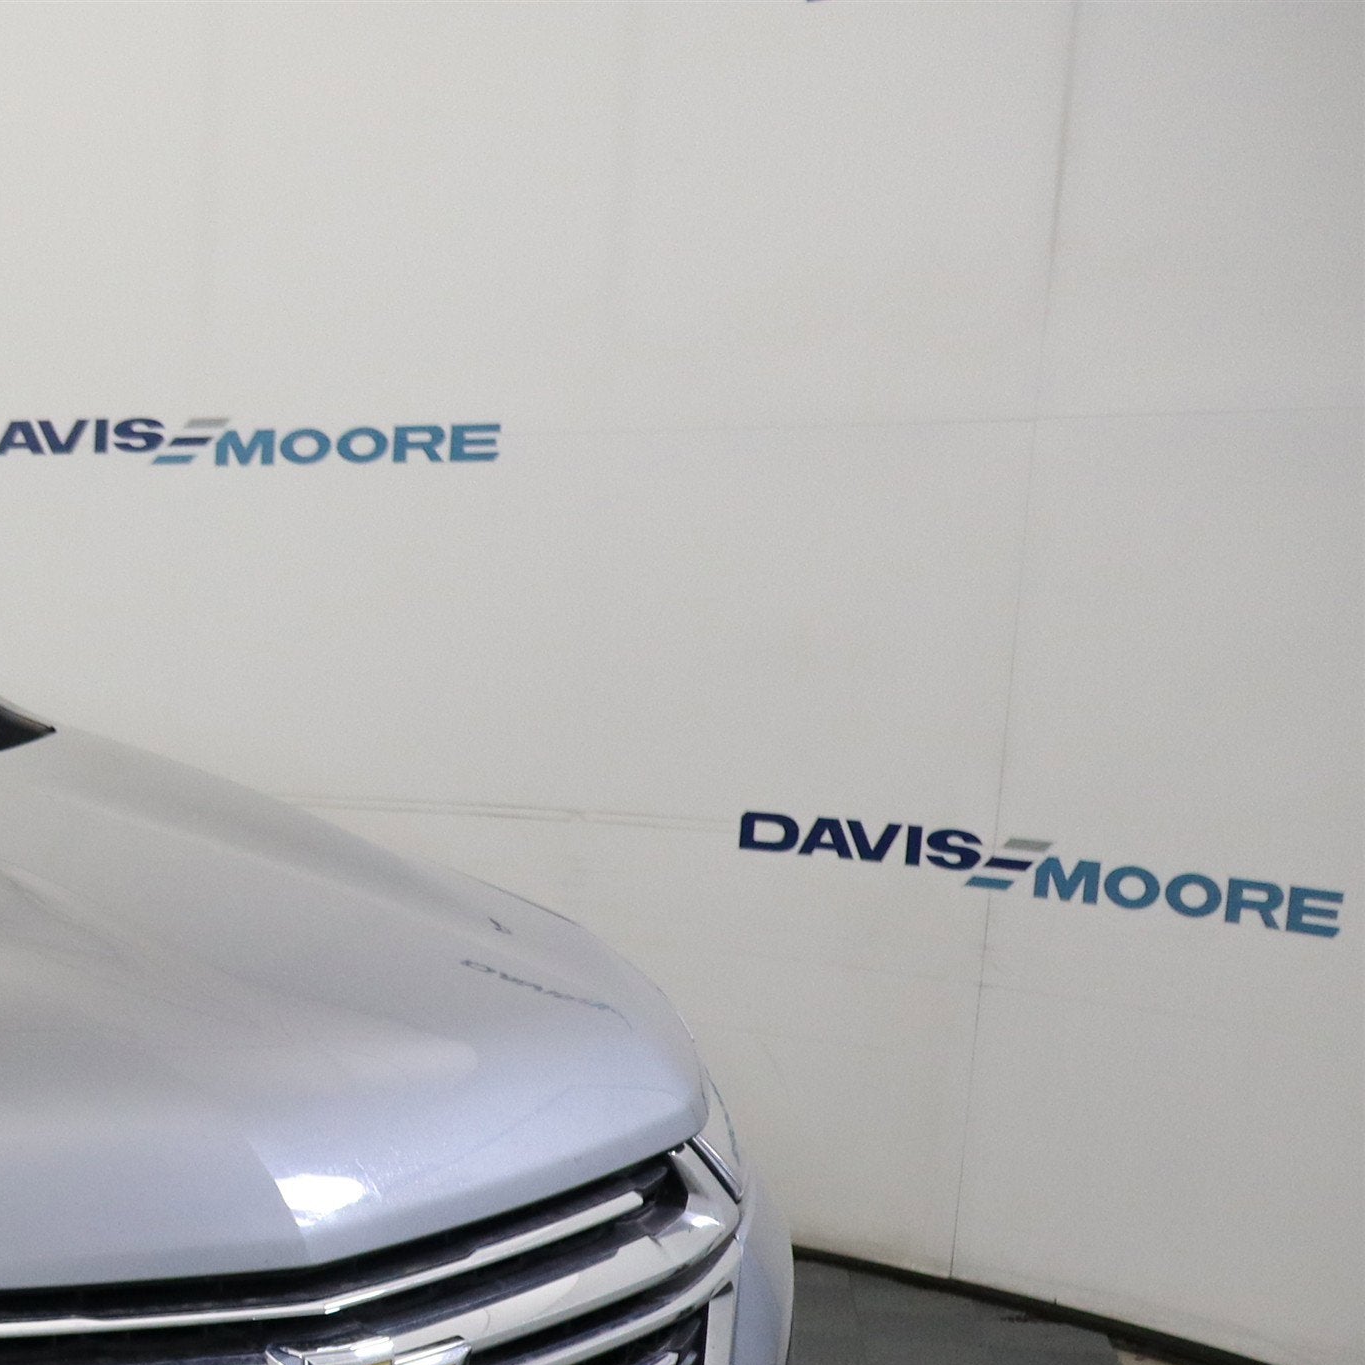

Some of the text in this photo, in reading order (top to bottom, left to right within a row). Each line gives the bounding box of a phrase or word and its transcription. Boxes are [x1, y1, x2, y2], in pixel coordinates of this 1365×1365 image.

[213, 422, 502, 468] MOORE
[738, 809, 1346, 940] DAVIS MOORE
